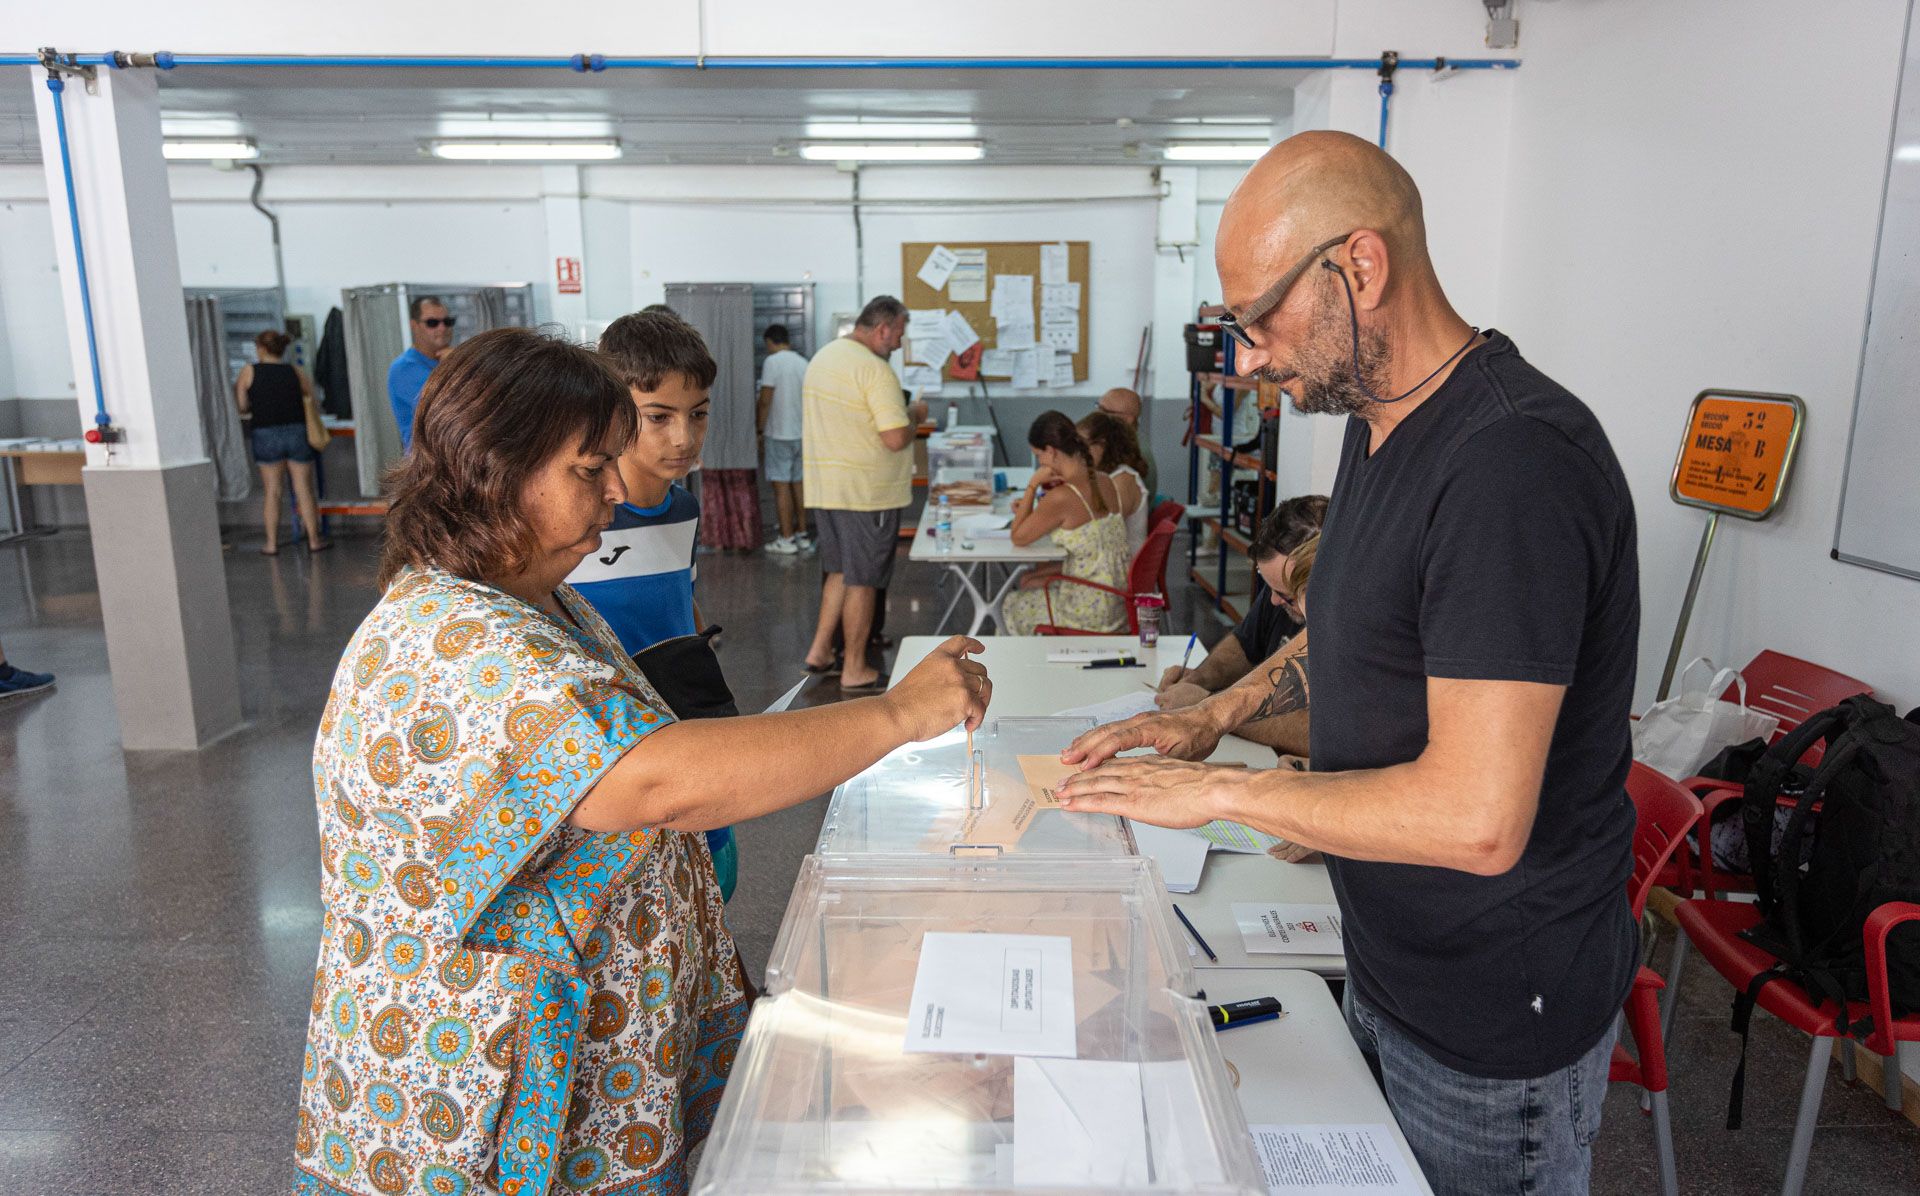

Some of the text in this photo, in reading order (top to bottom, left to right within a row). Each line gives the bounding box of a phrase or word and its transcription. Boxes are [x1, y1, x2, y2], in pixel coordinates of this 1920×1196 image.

[1695, 433, 1765, 458] MESA B
[1753, 471, 1767, 492] Z
